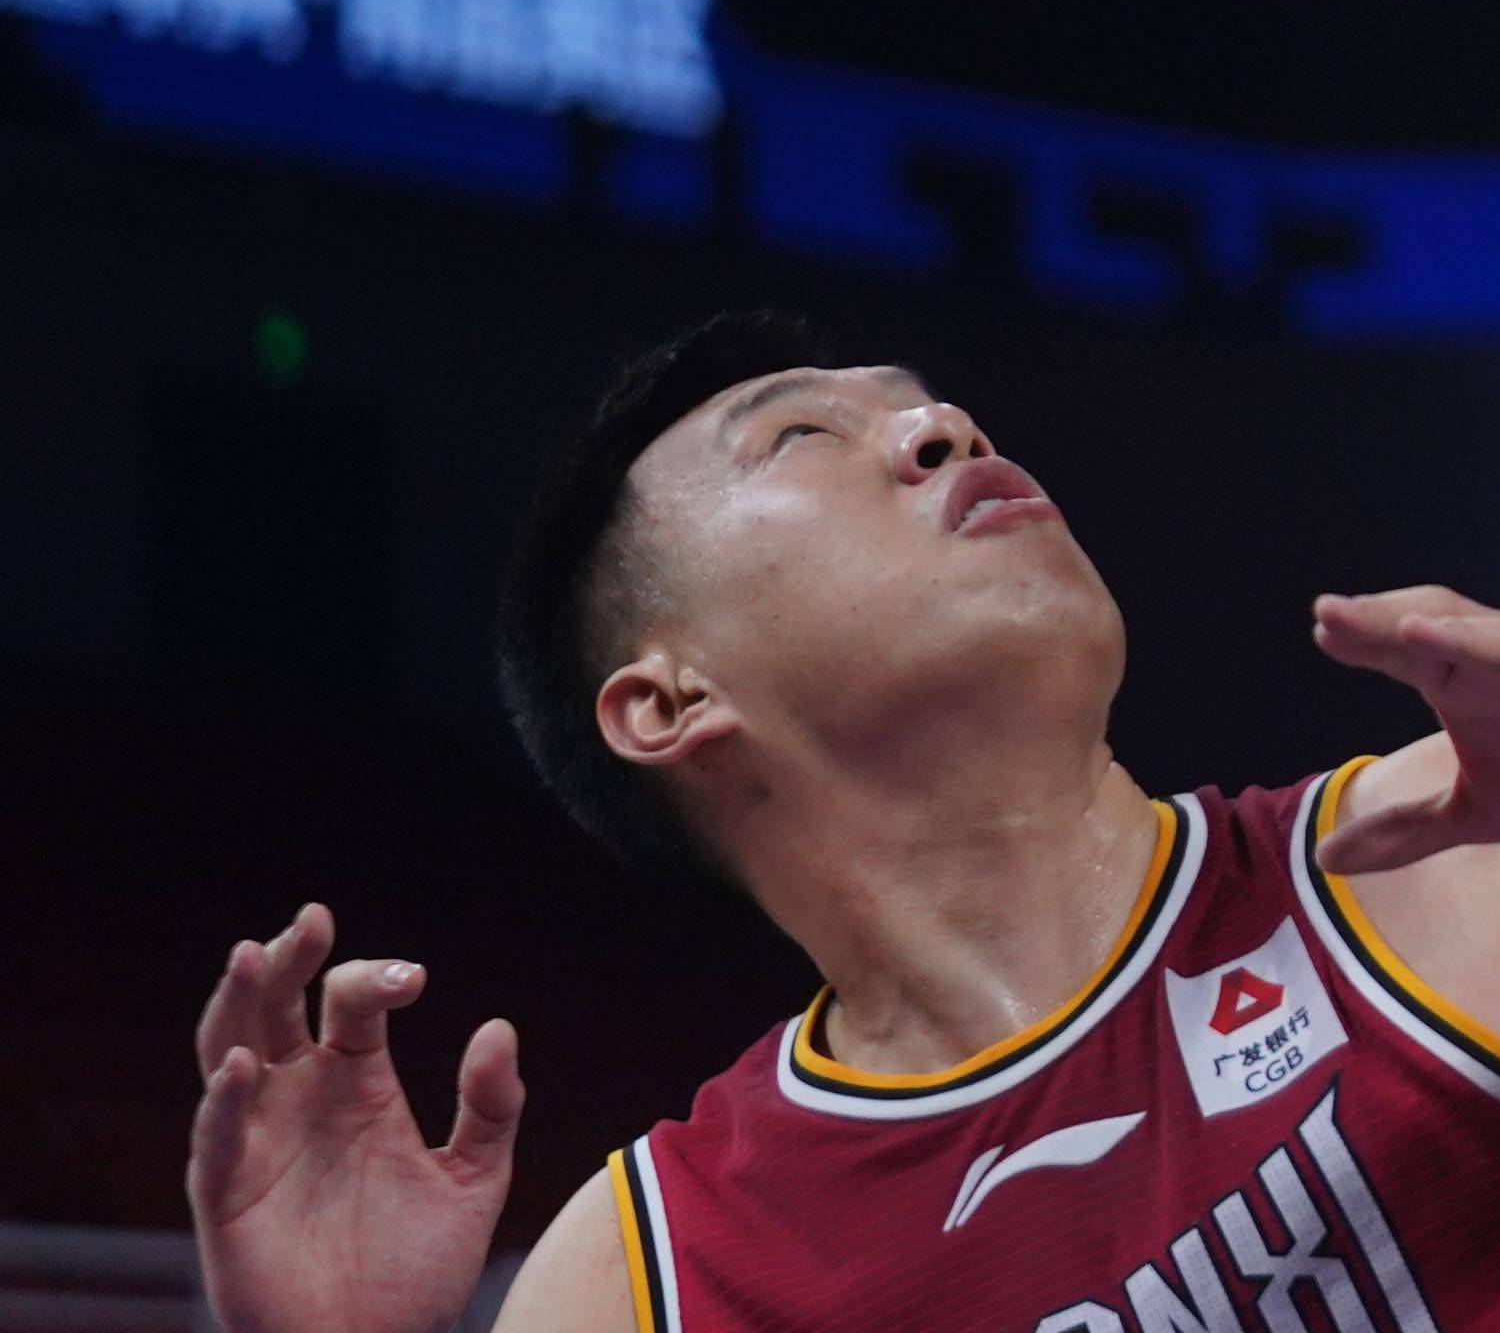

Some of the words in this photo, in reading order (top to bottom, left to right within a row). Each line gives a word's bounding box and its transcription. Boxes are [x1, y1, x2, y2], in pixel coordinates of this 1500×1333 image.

[1213, 1005, 1311, 1078] 广发银行
[1244, 1045, 1305, 1093] CGB
[1031, 1069, 1446, 1333] NXI
